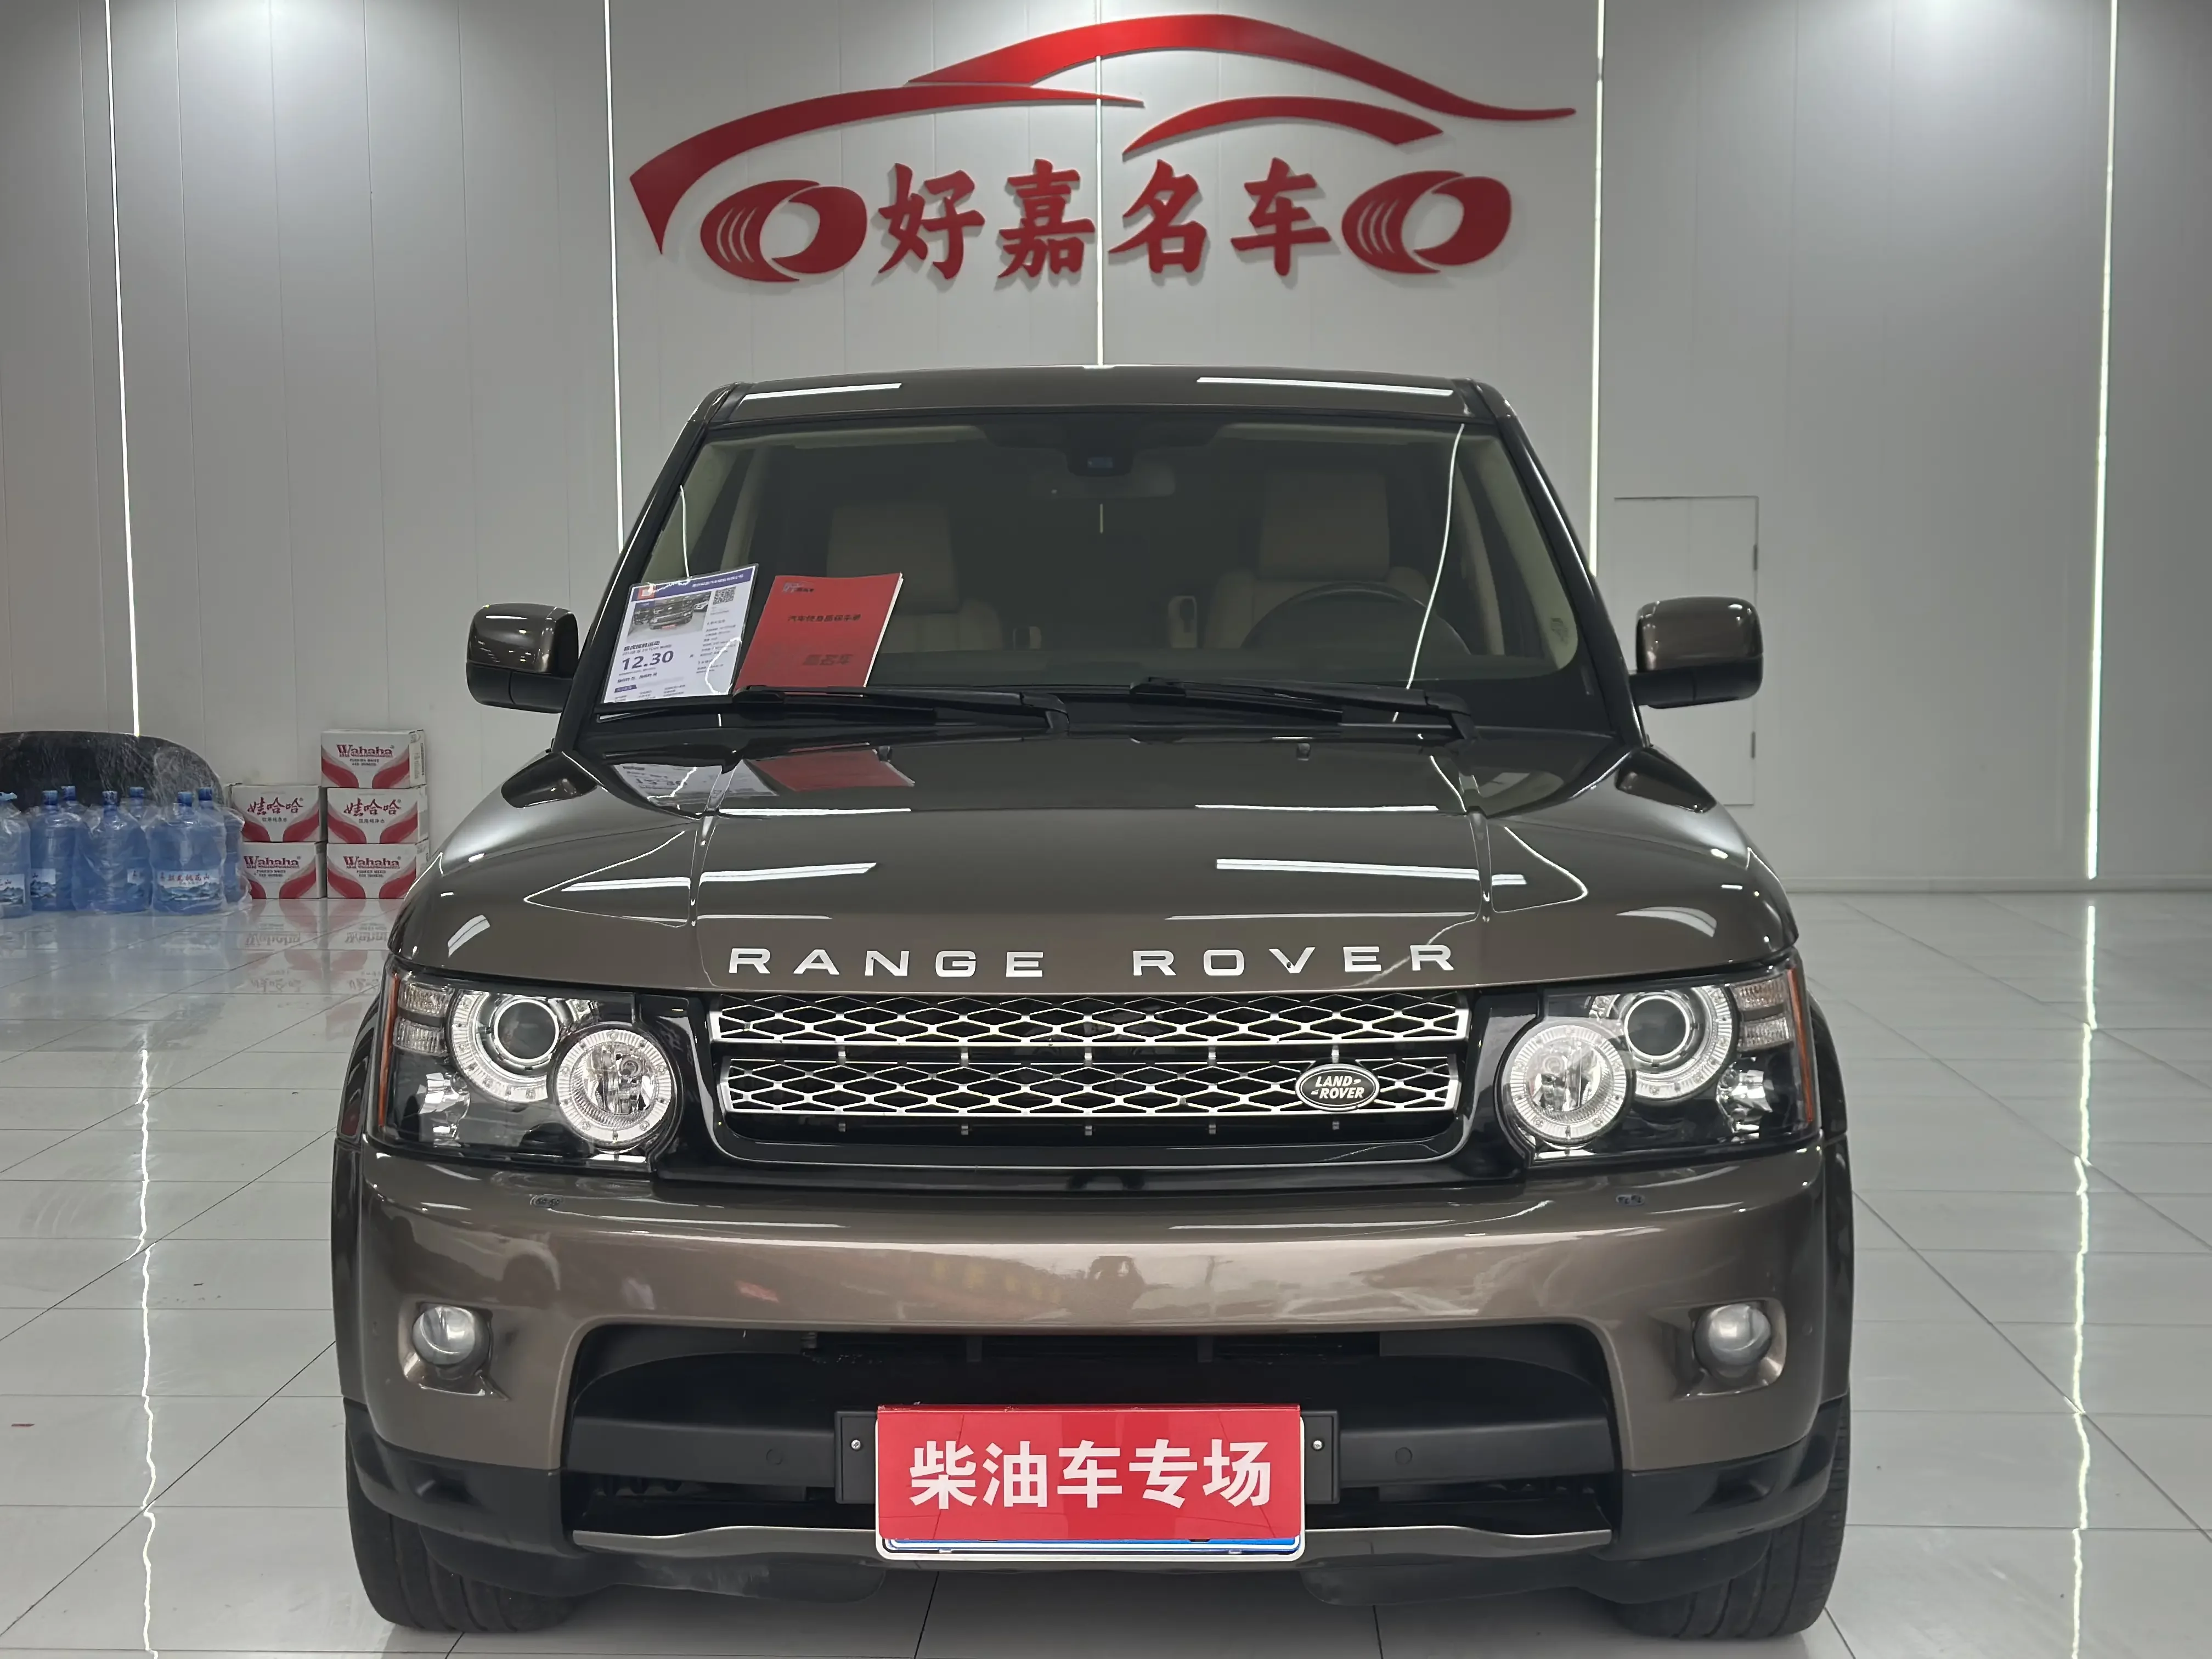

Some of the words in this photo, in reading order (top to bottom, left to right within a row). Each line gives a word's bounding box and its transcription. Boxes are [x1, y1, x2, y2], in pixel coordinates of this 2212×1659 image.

[877, 158, 1331, 279] 好嘉名车
[622, 651, 674, 670] 12.30
[336, 744, 393, 758] Wahaha
[247, 797, 303, 815] 娃哈哈
[343, 798, 402, 817] 娃哈哈
[244, 855, 300, 869] Wahaha
[343, 856, 400, 869] Wahaha
[729, 948, 1043, 978] RANGE
[1132, 944, 1455, 977] ROVER
[1315, 1075, 1353, 1087] LAND
[1319, 1087, 1365, 1099] ROVER
[909, 1438, 1271, 1509] 柴油车专场
